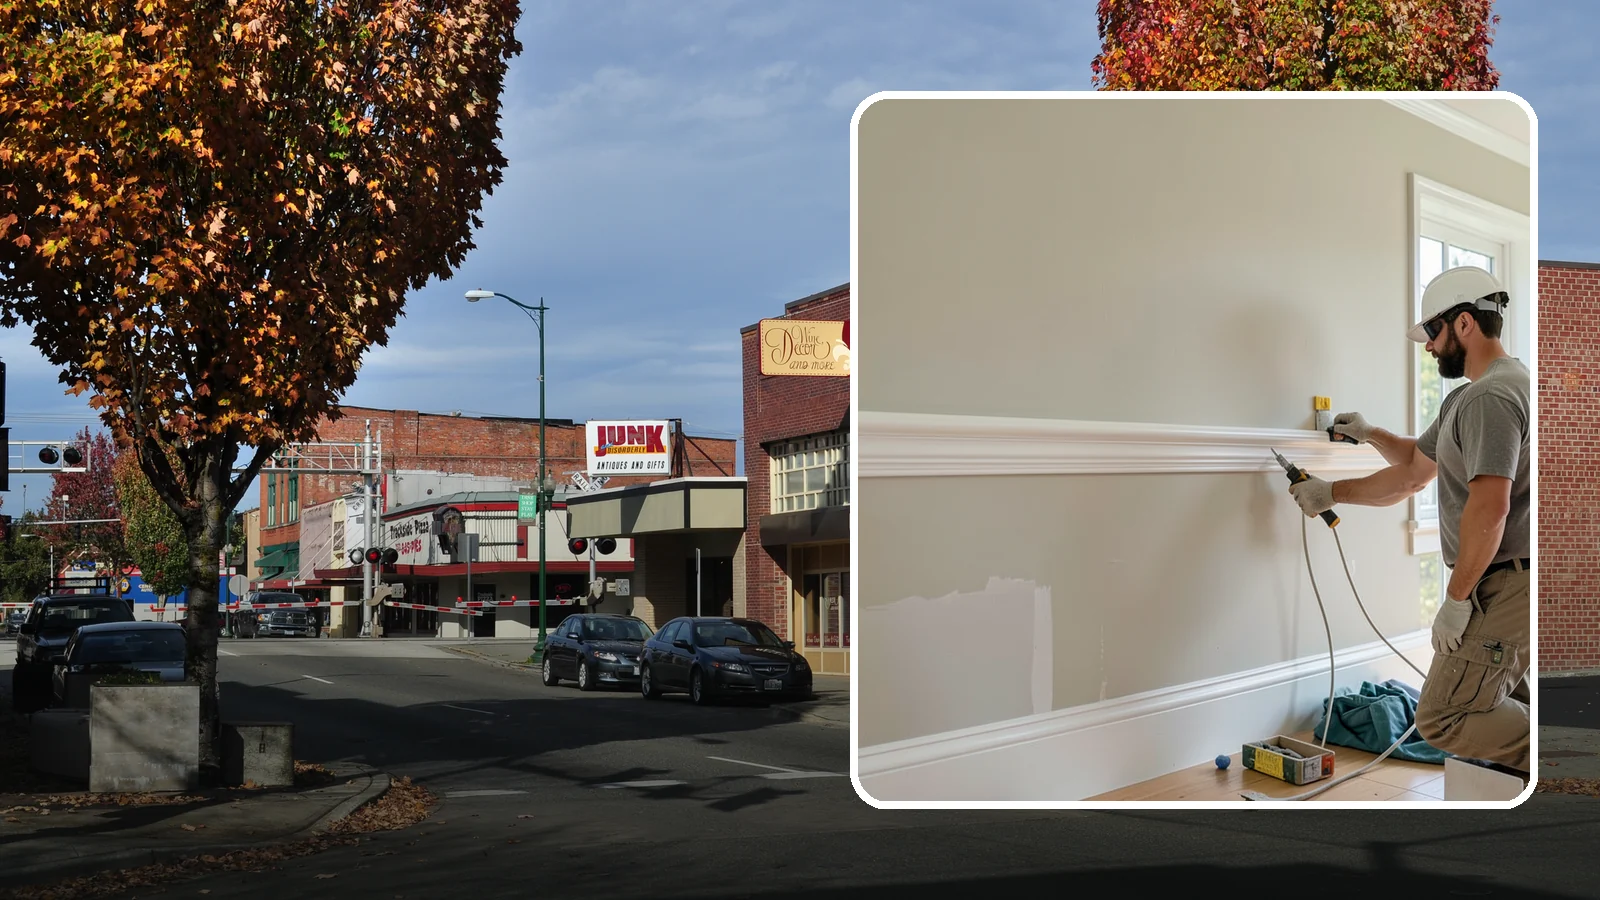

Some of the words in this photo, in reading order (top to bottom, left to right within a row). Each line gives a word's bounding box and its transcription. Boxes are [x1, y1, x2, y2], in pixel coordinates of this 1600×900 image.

[765, 328, 831, 365] Decor
[595, 425, 665, 457] JUNK
[607, 446, 645, 454] DISORDERLY
[597, 461, 628, 470] ANTIQUES
[631, 461, 643, 470] AND
[647, 460, 665, 469] GIFTS
[415, 520, 429, 535] Pizza
